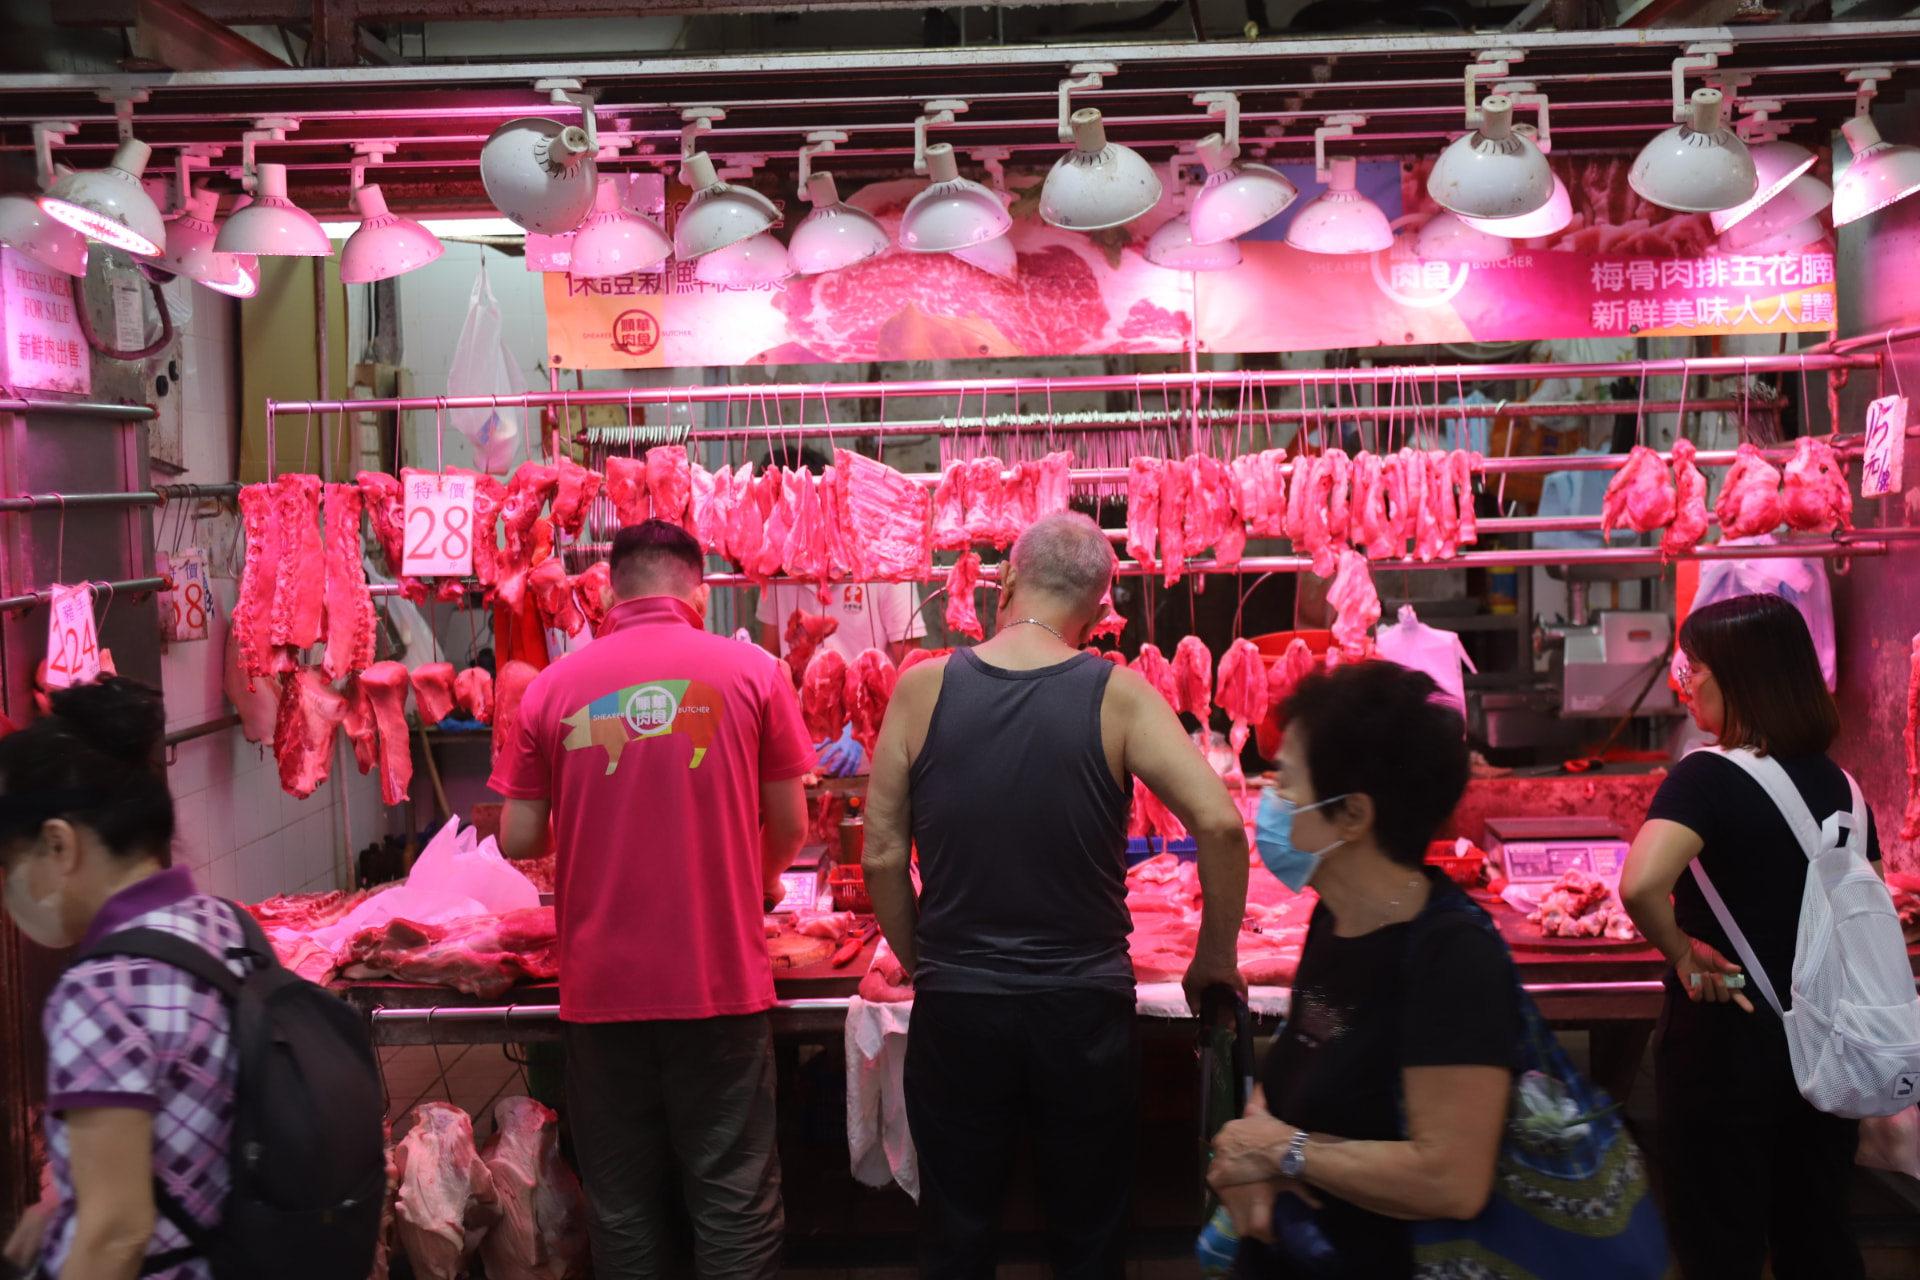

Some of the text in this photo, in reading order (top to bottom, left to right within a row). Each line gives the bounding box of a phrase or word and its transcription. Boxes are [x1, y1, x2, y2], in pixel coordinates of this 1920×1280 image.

[1308, 261, 1368, 275] SHEARER
[1590, 253, 1834, 292] 梅骨肉排五花腩
[16, 268, 73, 297] FRESH MEA
[24, 297, 71, 324] FOR SALE
[1591, 293, 1835, 332] 新鮮美味人人讚
[18, 331, 80, 368] 新鮮肉出售
[414, 481, 465, 500] 特價
[406, 505, 469, 561] 28
[593, 705, 710, 721] SHEARER BUTCHER
[636, 709, 669, 727] 肉食
